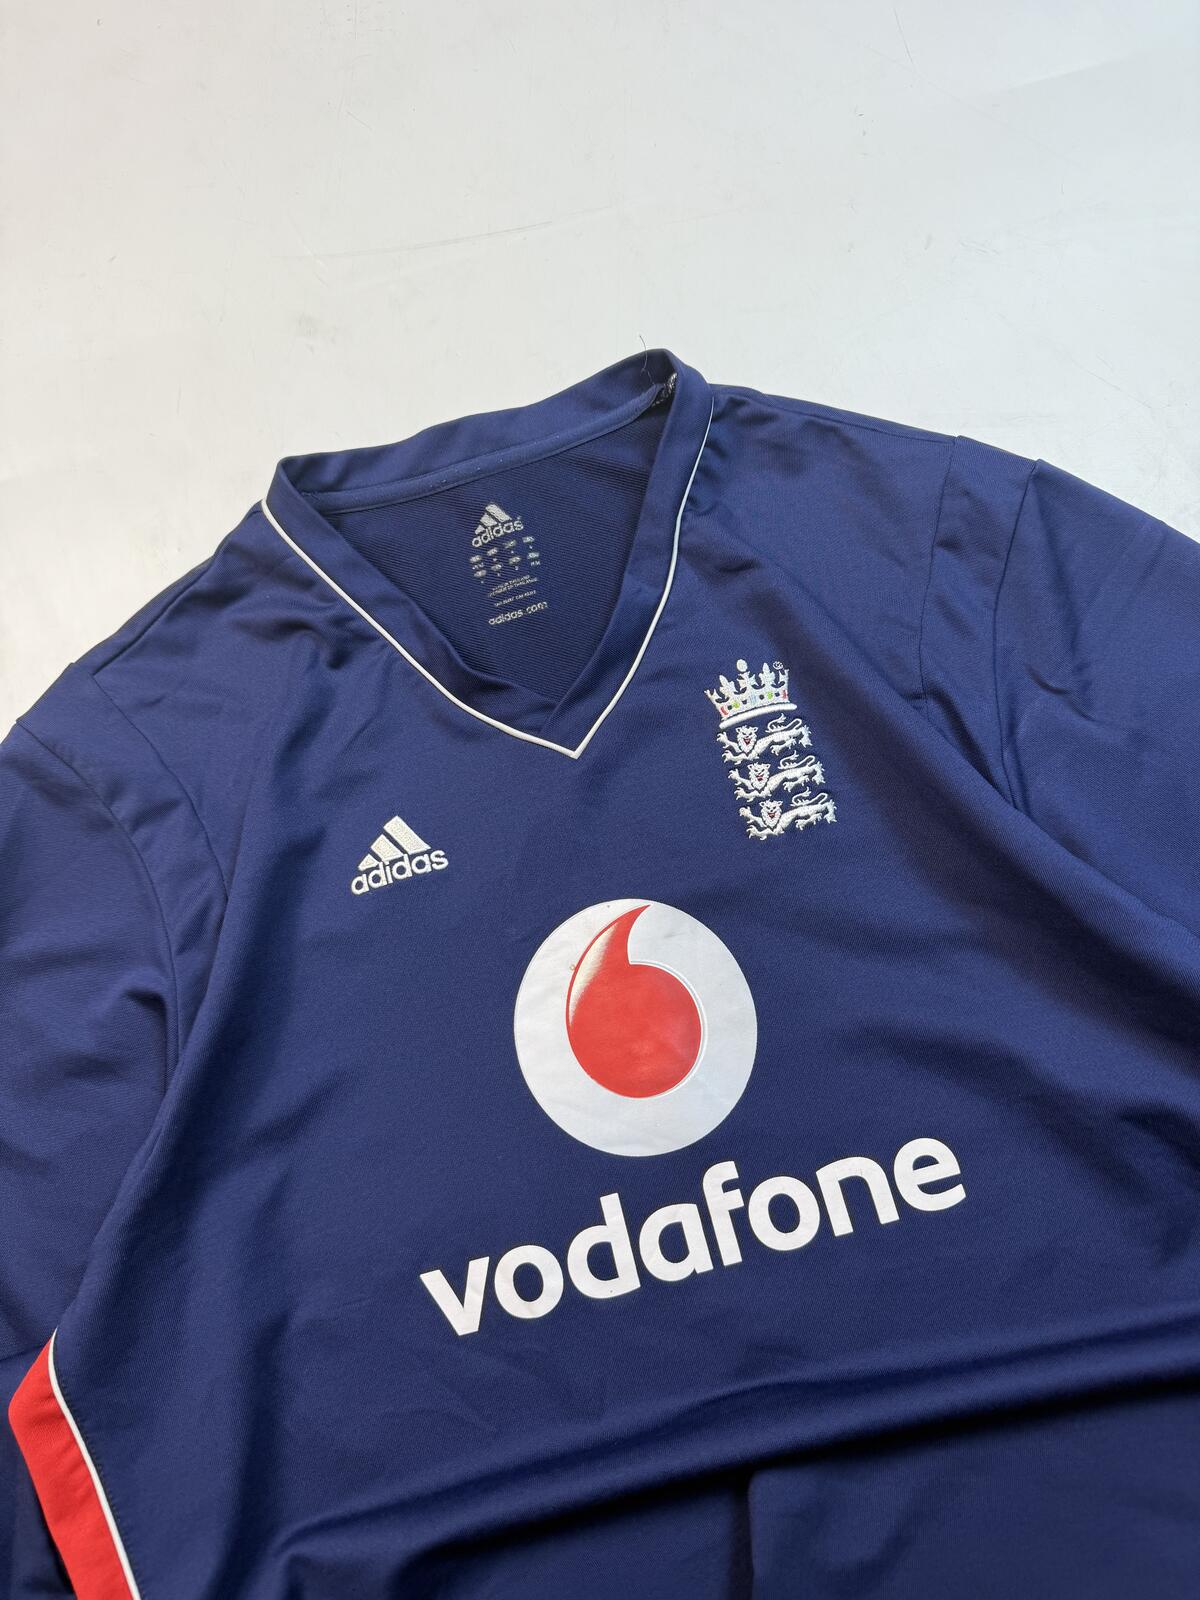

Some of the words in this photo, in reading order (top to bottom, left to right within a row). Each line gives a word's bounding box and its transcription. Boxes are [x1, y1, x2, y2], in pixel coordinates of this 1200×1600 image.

[471, 520, 524, 548] adidas
[351, 850, 449, 895] adidas
[419, 1137, 967, 1336] vodafone
